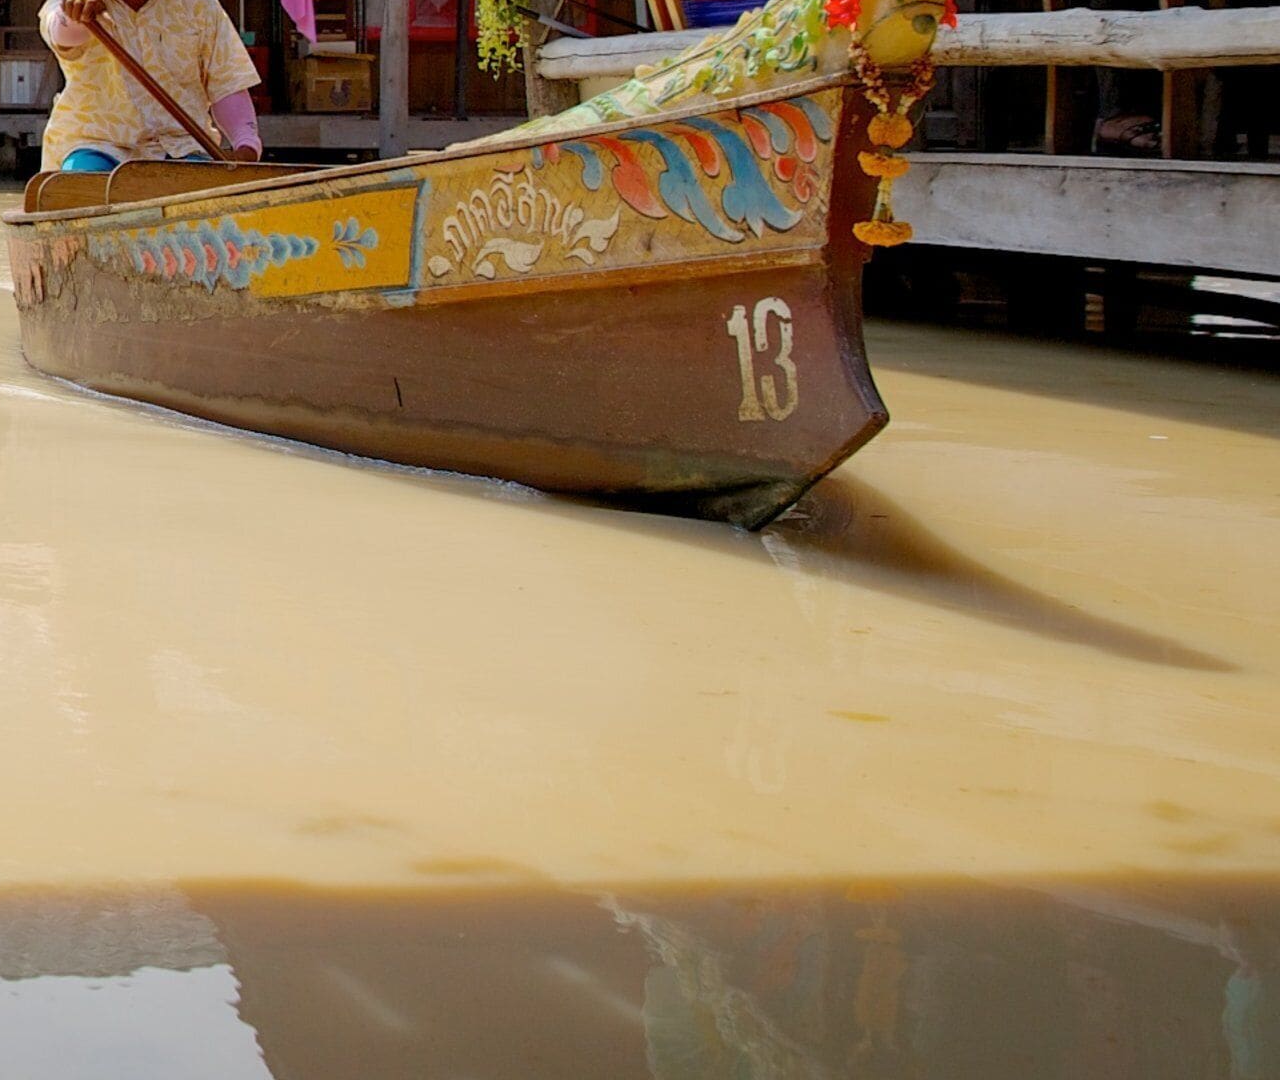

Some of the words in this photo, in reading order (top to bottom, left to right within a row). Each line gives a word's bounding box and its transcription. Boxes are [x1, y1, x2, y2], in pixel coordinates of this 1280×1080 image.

[443, 167, 584, 263] ภาคอีสาน
[727, 297, 799, 421] 13
